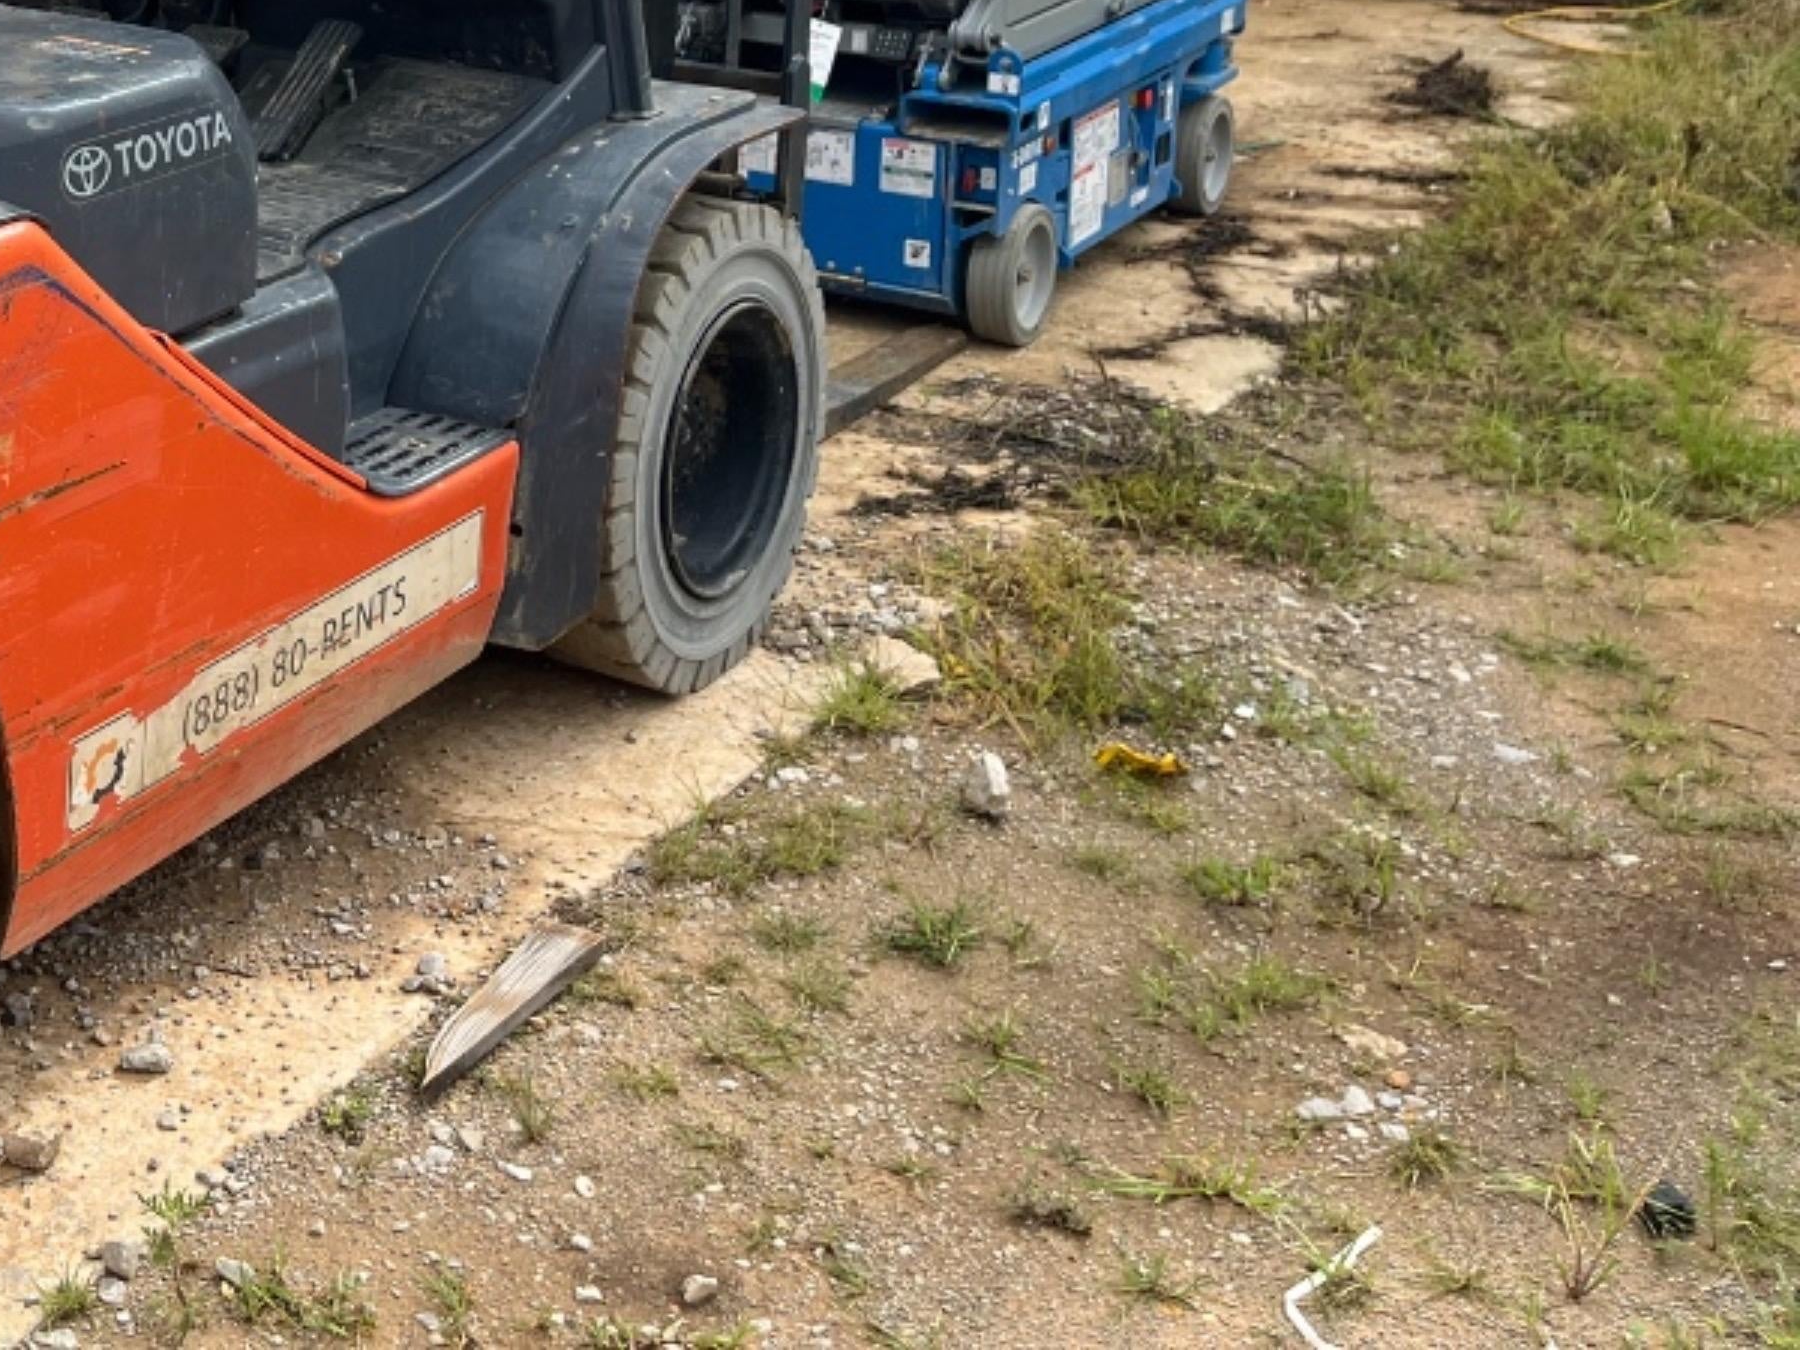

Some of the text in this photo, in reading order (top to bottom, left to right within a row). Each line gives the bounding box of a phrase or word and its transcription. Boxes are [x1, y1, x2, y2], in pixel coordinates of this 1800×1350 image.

[114, 111, 232, 177] TOYOTA
[182, 576, 407, 746] (888) 80-RENTS
